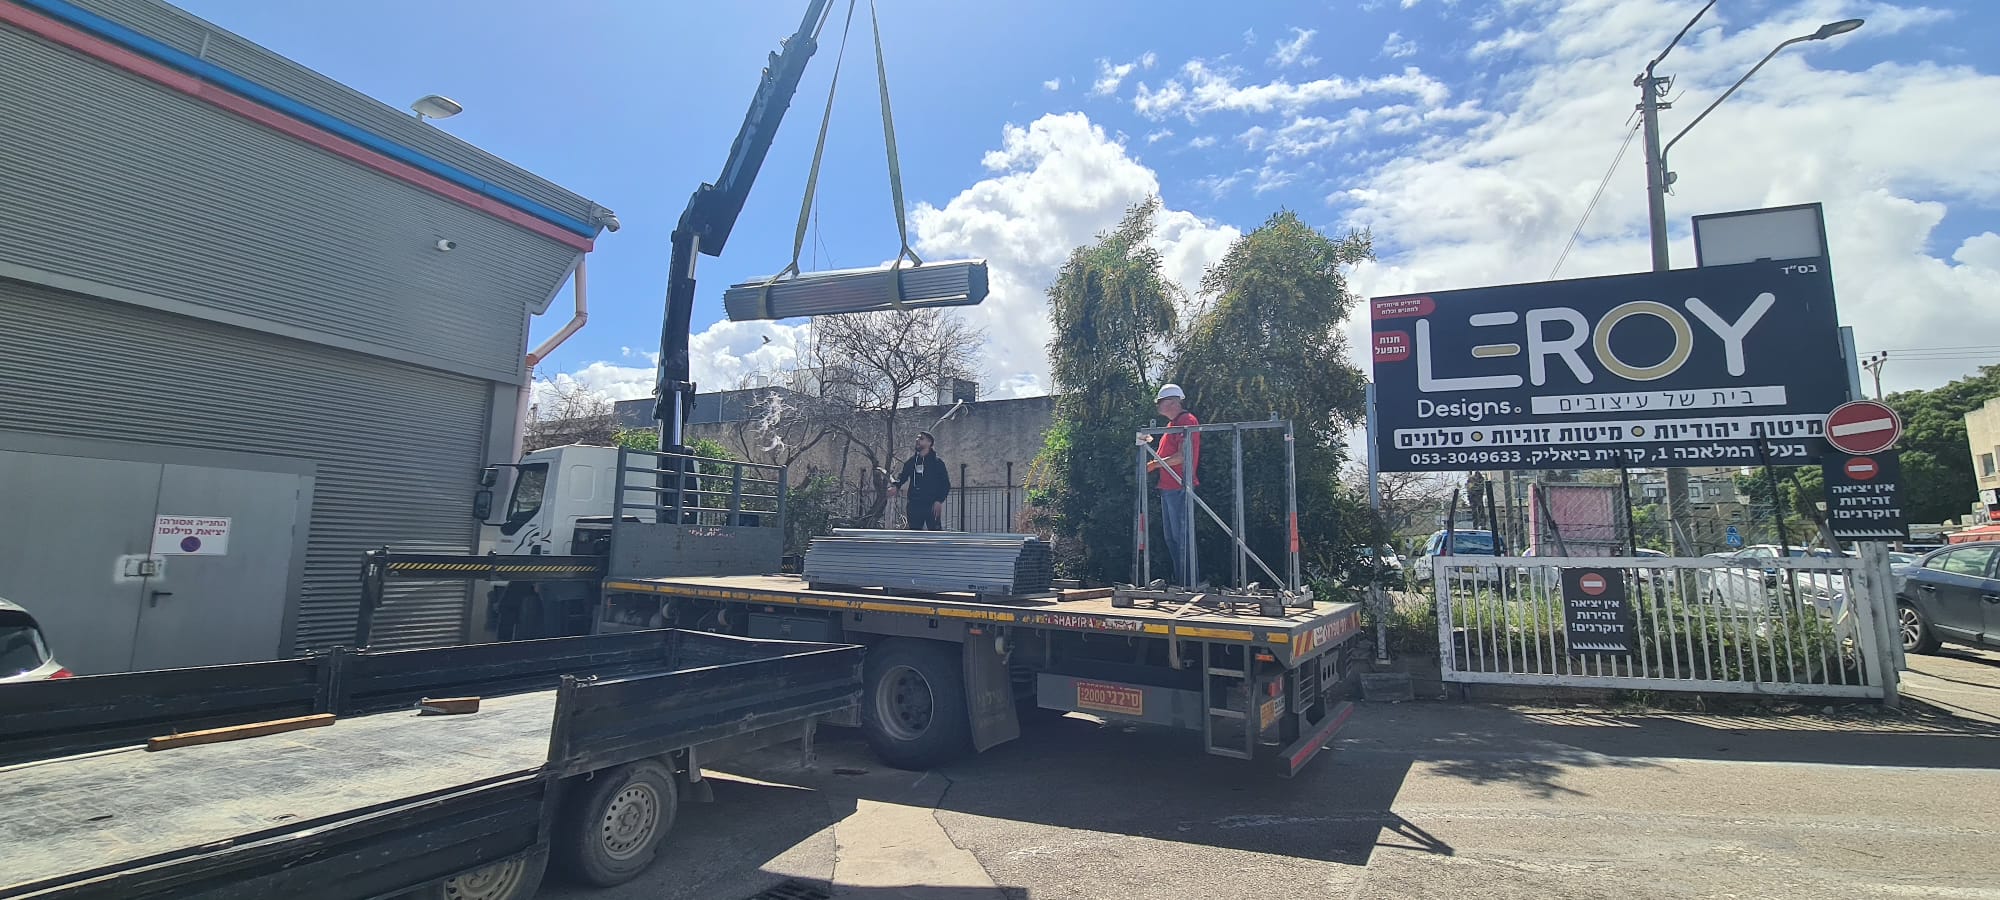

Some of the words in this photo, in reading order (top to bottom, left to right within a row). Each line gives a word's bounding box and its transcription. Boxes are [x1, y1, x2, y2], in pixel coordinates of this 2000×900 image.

[1379, 336, 1401, 344] חנות
[1415, 292, 1776, 393] LEROY
[1374, 346, 1406, 355] המפעל
[1559, 395, 1648, 411] עיצובים
[1663, 391, 1695, 407] של
[1712, 390, 1755, 406] בית
[1559, 426, 1623, 442] מיטות
[1654, 422, 1739, 440] יהודיות
[1749, 419, 1824, 437] מיטות
[1400, 429, 1464, 447] סלונים
[1491, 428, 1551, 444] זוגיות
[1526, 447, 1591, 465] ביאליק.
[1595, 448, 1646, 463] קריית
[1674, 442, 1755, 459] המלאכה
[1759, 441, 1808, 458] בעל
[1410, 450, 1521, 465] 053-3049633
[1832, 485, 1872, 494] יציאה
[1874, 484, 1896, 494] אין
[1839, 496, 1891, 506] זהירות
[1833, 508, 1901, 520] דוקרנים!
[1570, 599, 1602, 608] יציאה
[1603, 600, 1620, 609] אין
[1576, 611, 1617, 620] זהירות
[1571, 622, 1625, 634] דוקרנים!
[1084, 688, 1105, 703] 2000
